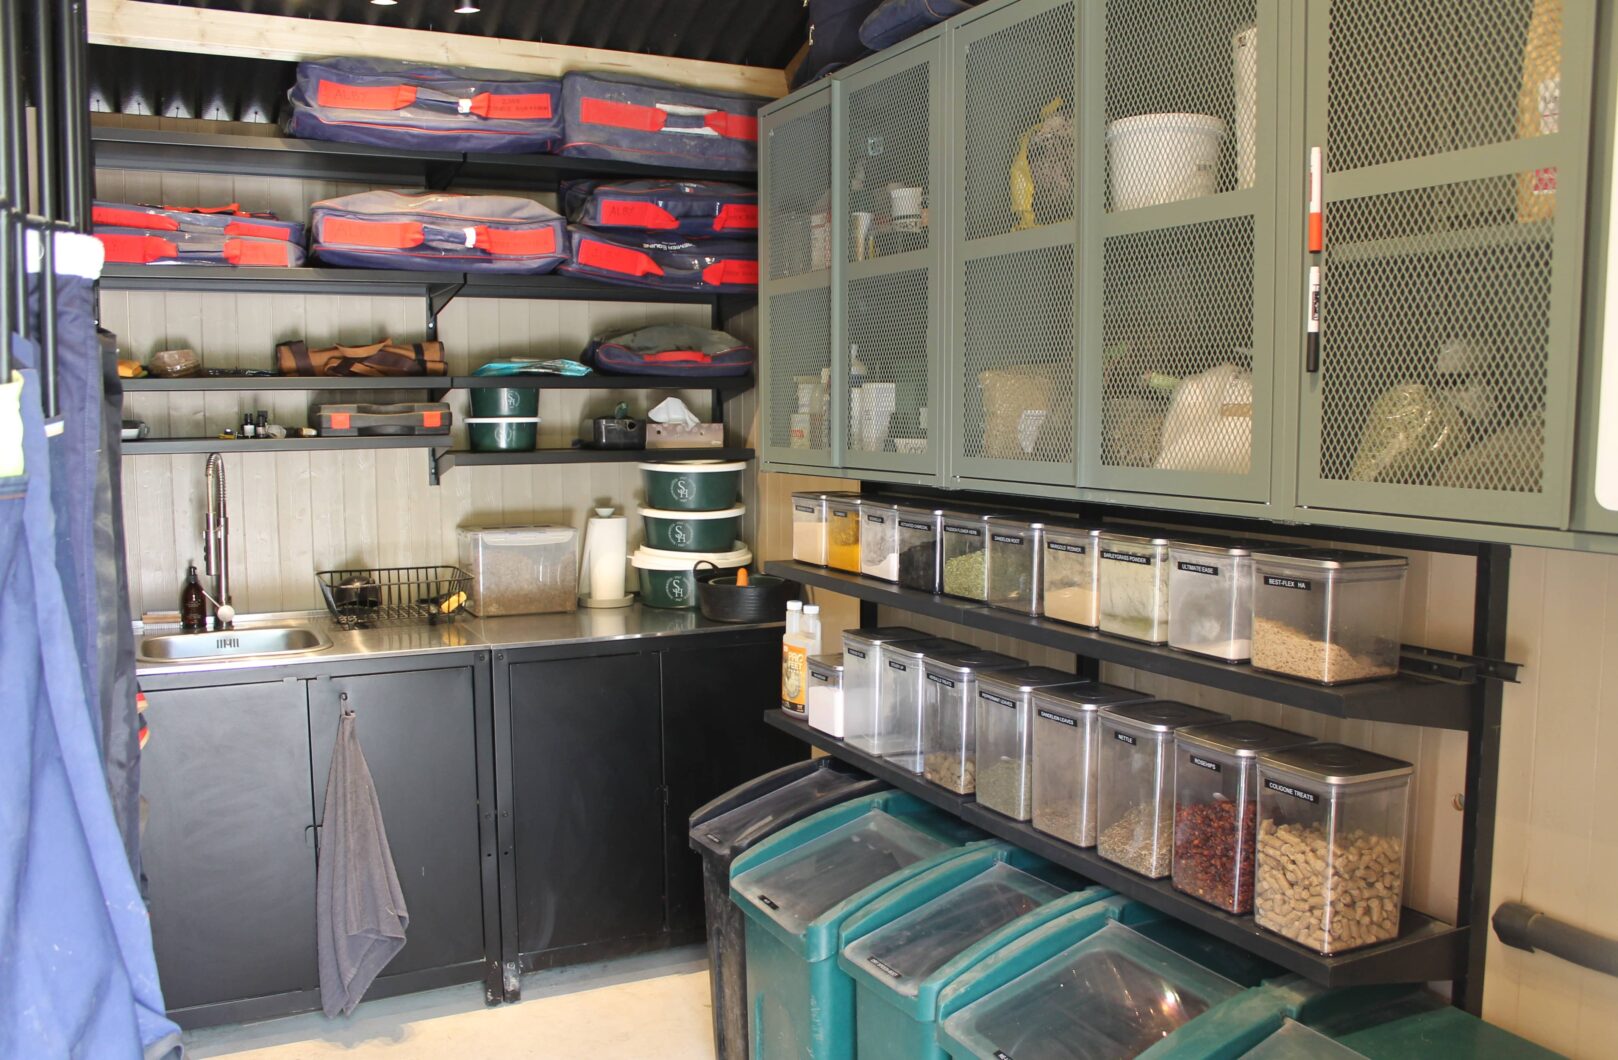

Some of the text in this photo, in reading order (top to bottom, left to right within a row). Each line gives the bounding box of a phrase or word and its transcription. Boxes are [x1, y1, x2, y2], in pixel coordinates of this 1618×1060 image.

[1182, 563, 1214, 574] ULTIMATE EASE
[1269, 578, 1295, 588] BEST-FLEX
[1118, 734, 1133, 744] NETTLE
[1194, 758, 1216, 770] ROSEHIPS
[1294, 789, 1314, 801] TREATS
